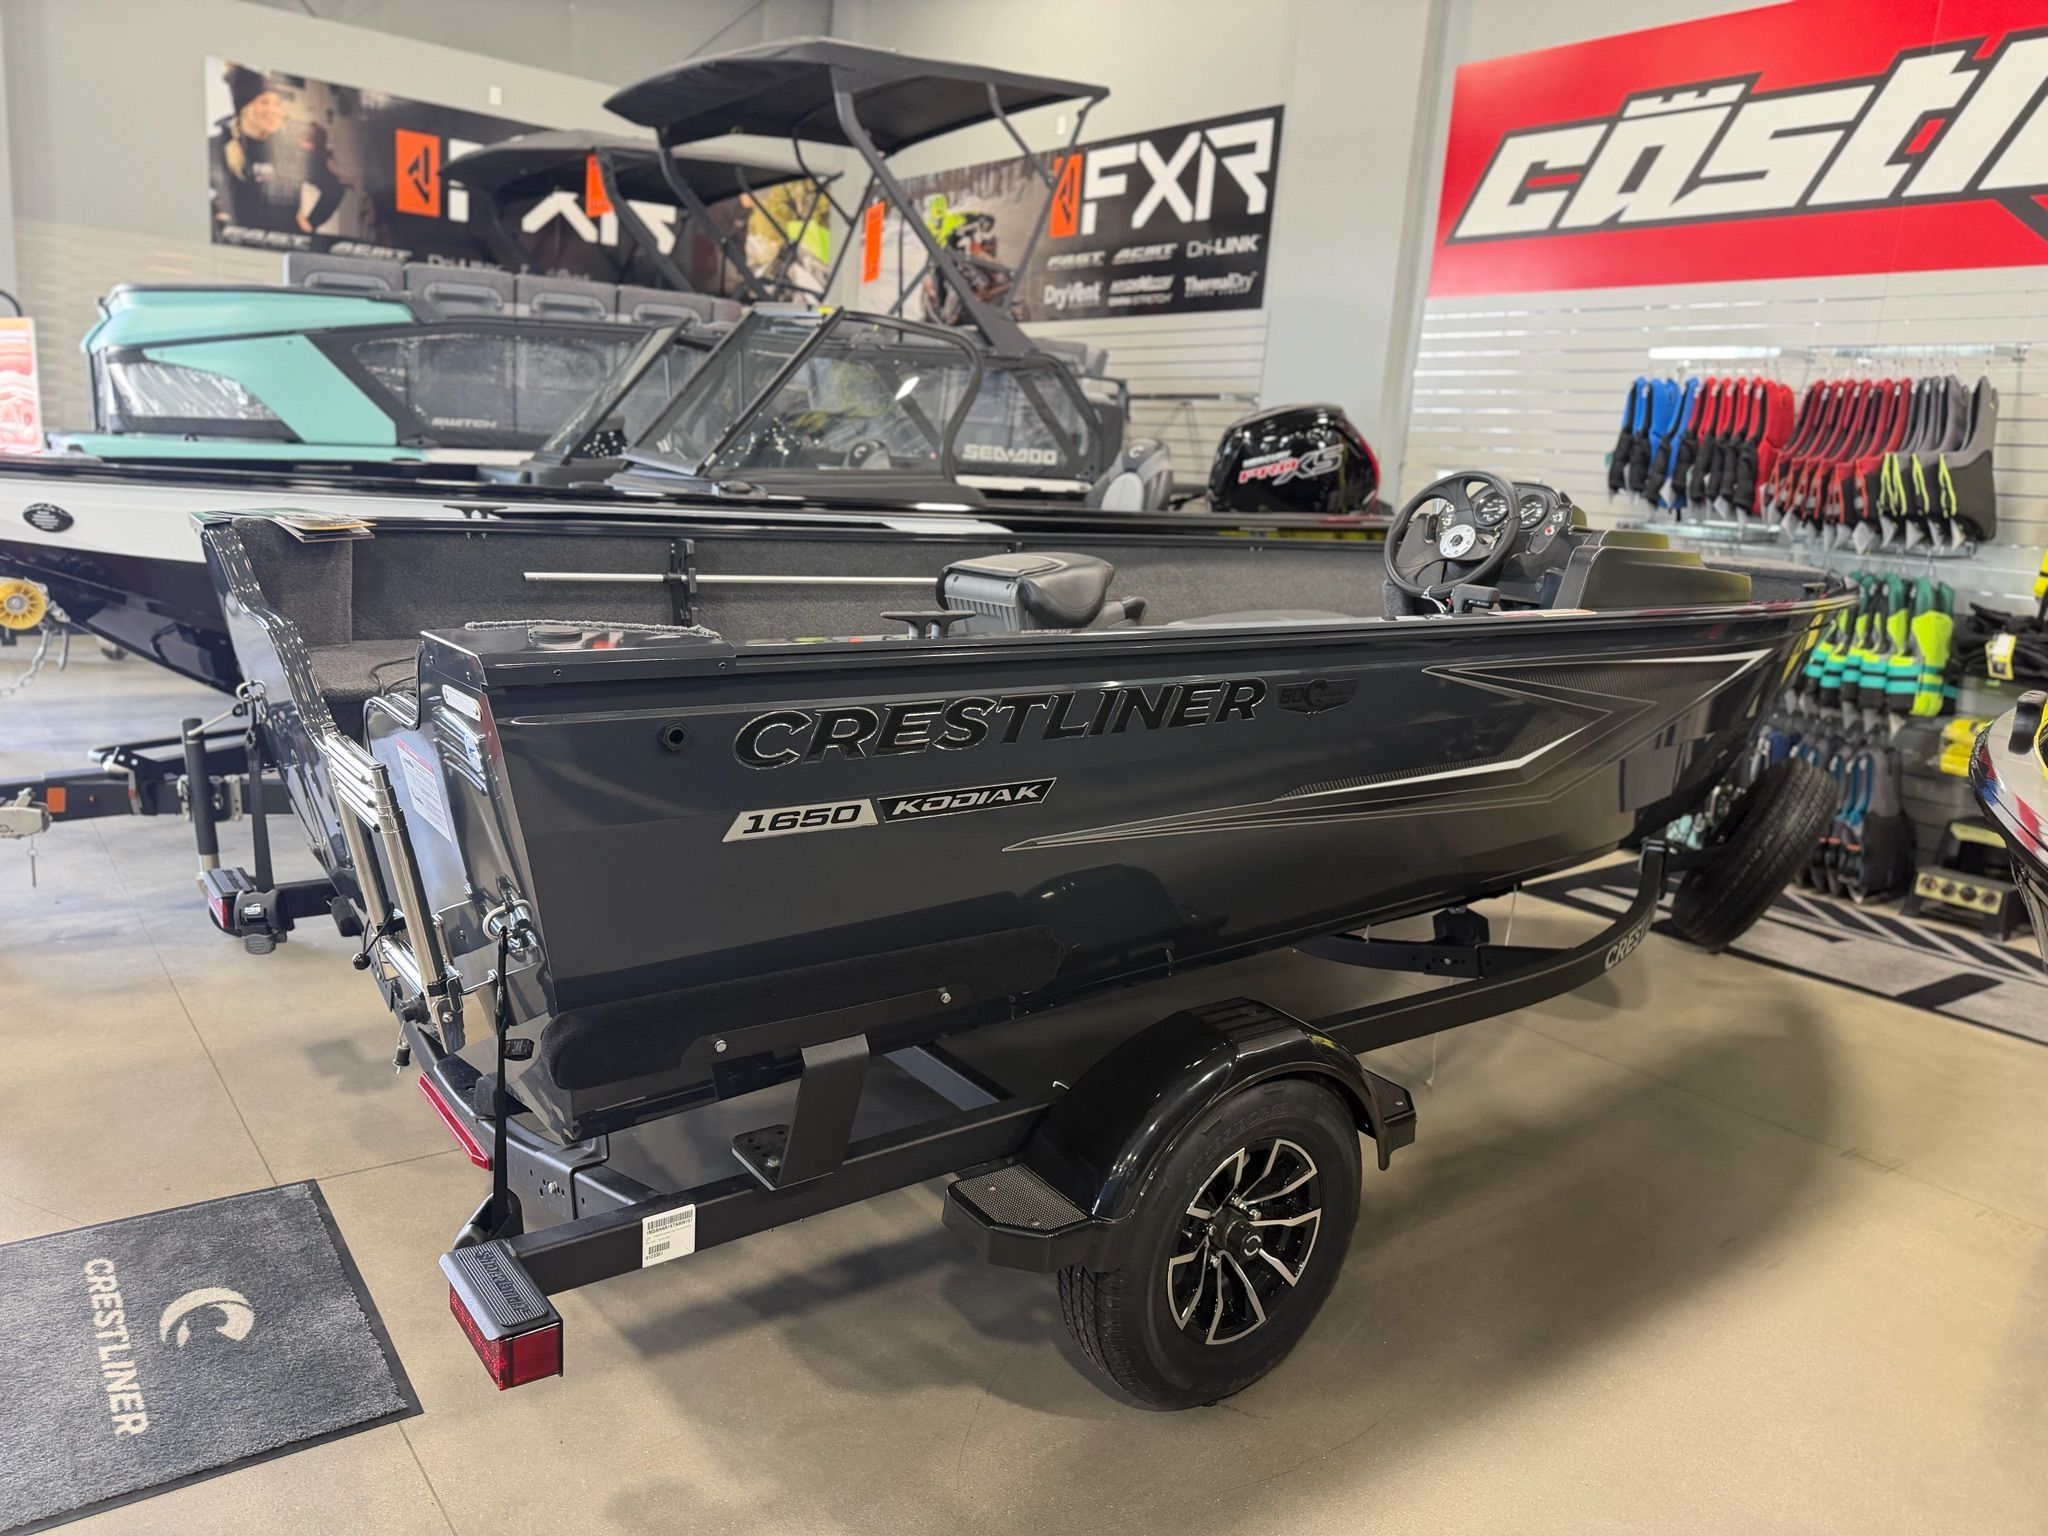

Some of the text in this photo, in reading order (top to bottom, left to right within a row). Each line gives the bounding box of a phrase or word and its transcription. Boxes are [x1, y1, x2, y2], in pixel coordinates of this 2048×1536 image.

[1080, 117, 1275, 236] FXR
[732, 676, 1269, 771] CRESTLINER
[742, 781, 1044, 835] 1650 KODIAK
[84, 1256, 151, 1436] CRESTLINER
